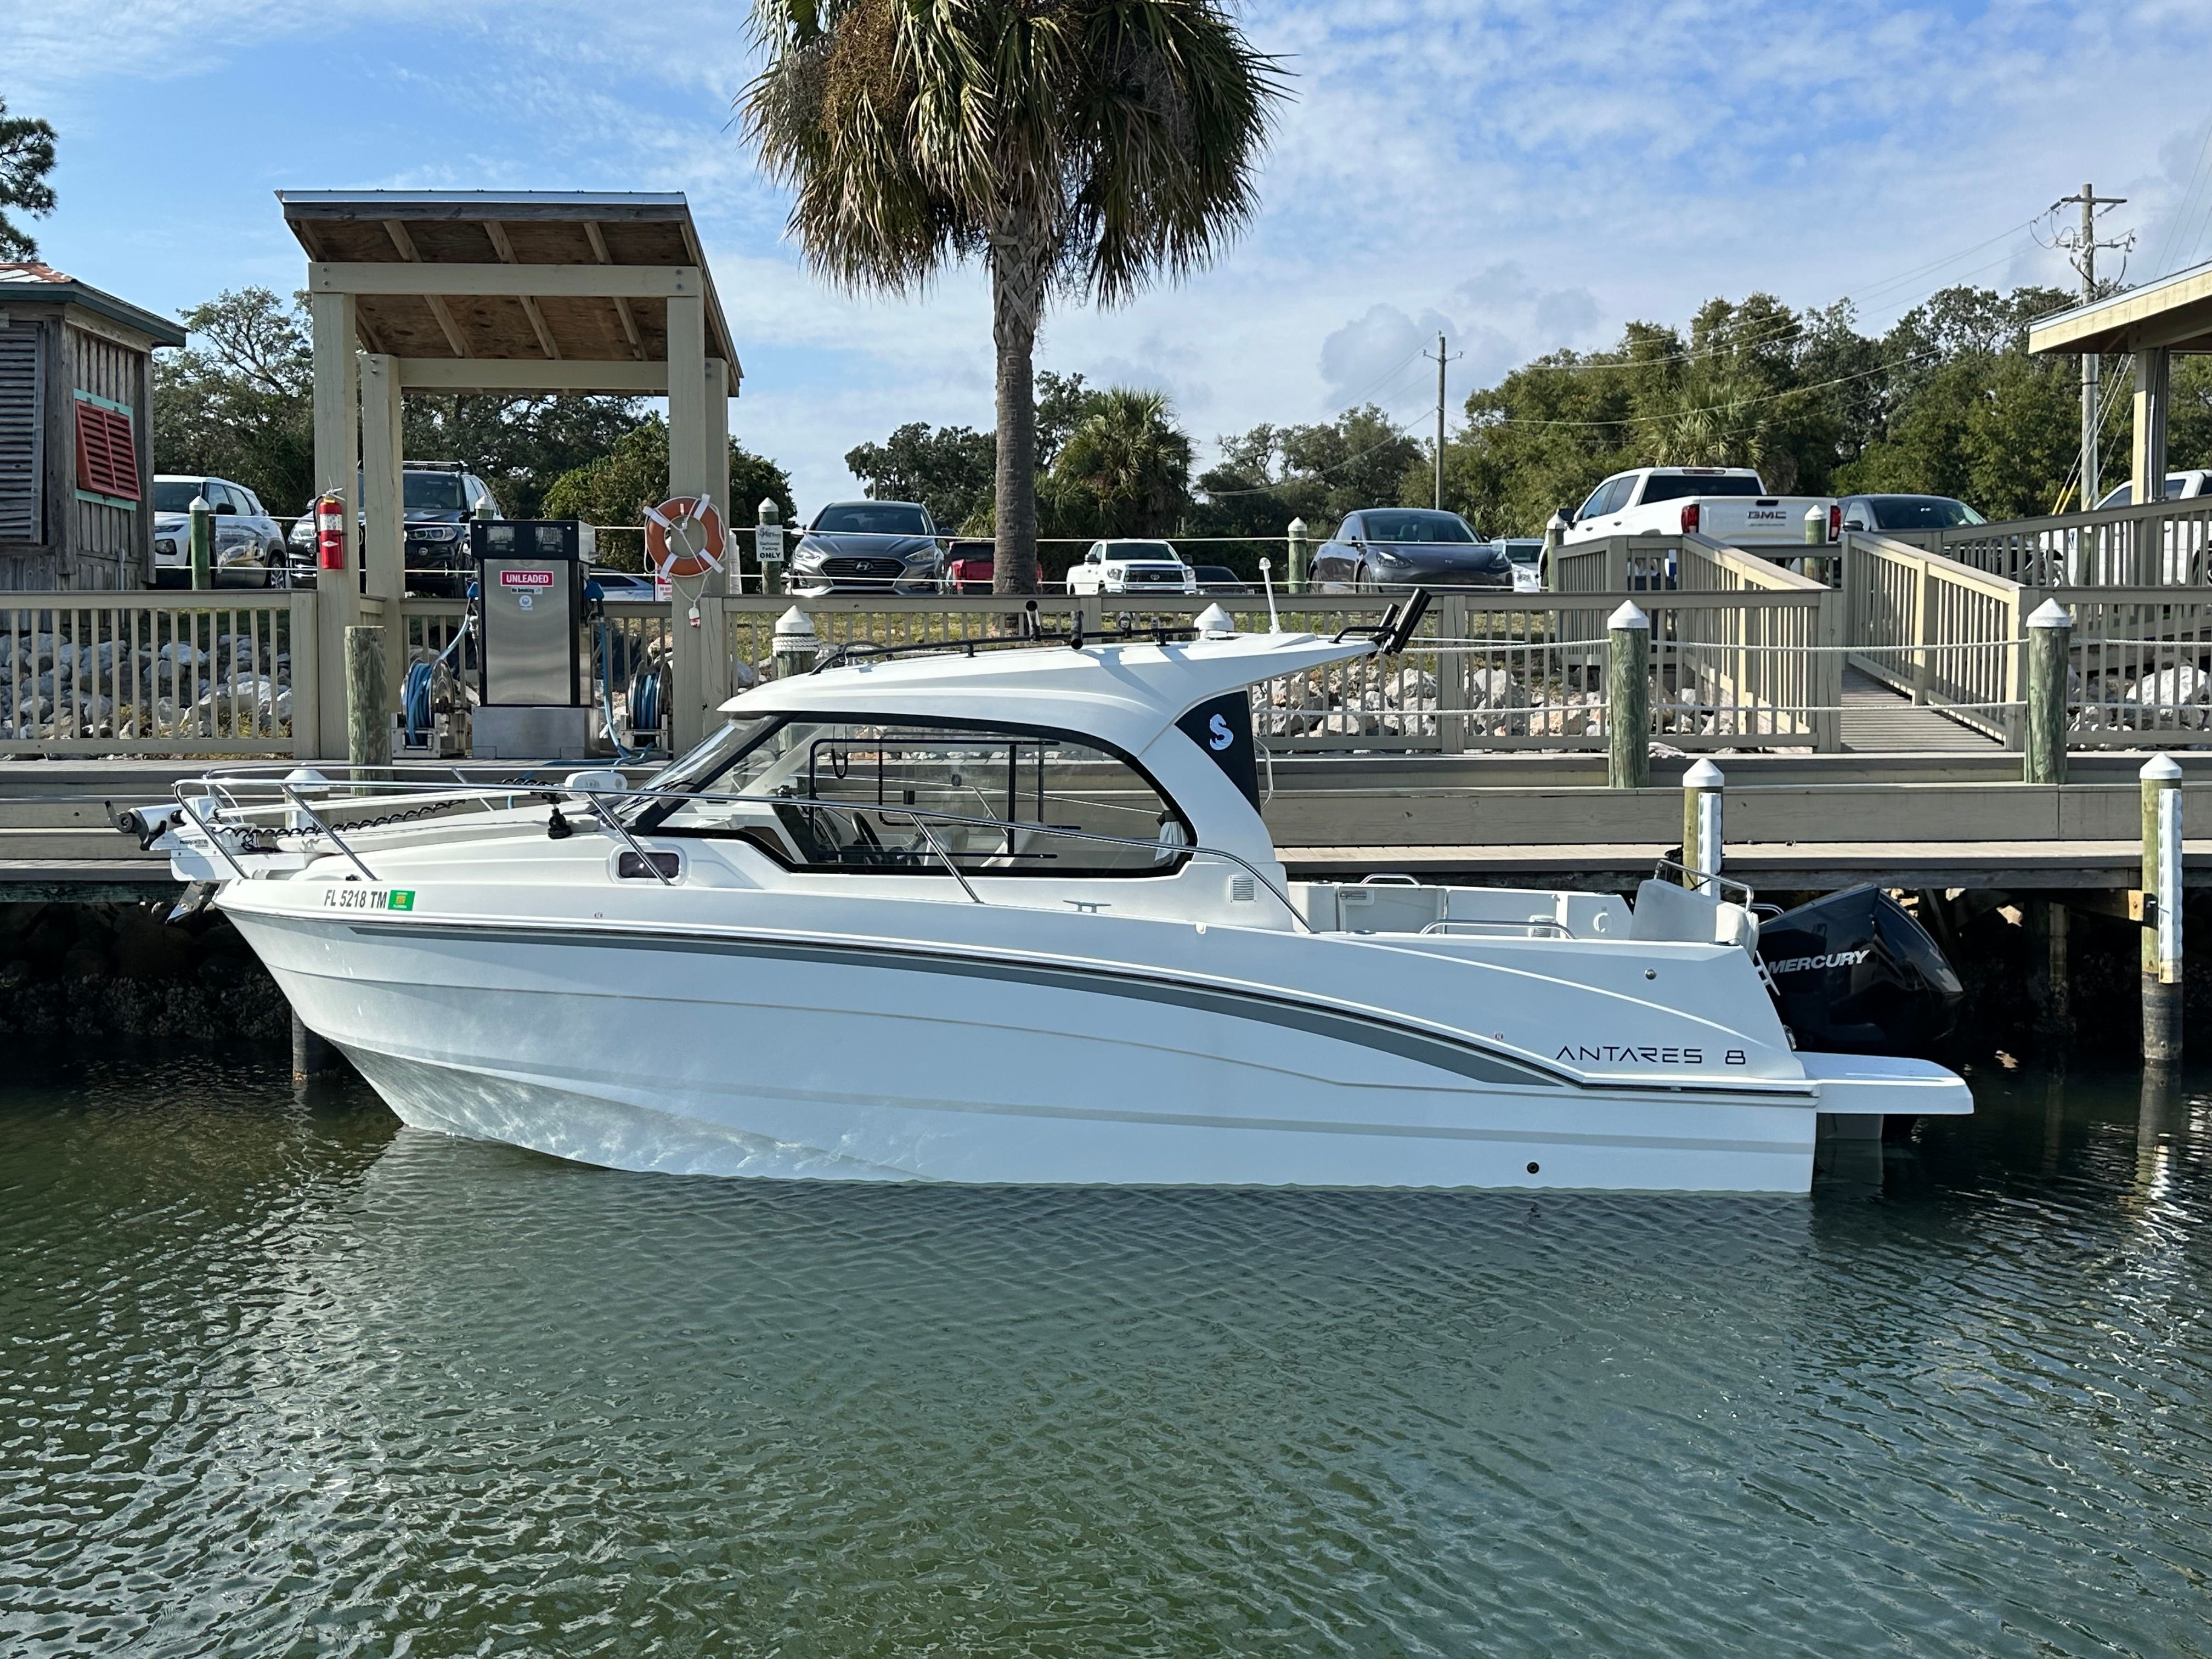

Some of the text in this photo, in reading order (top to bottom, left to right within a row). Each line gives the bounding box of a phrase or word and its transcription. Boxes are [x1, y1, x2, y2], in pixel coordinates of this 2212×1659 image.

[506, 574, 549, 583] UNLEADED
[324, 889, 336, 906] FL
[340, 890, 367, 908] 5218
[370, 891, 387, 909] TM
[1768, 949, 1870, 974] MERCURY
[1555, 1046, 1746, 1065] ANTARES 8
